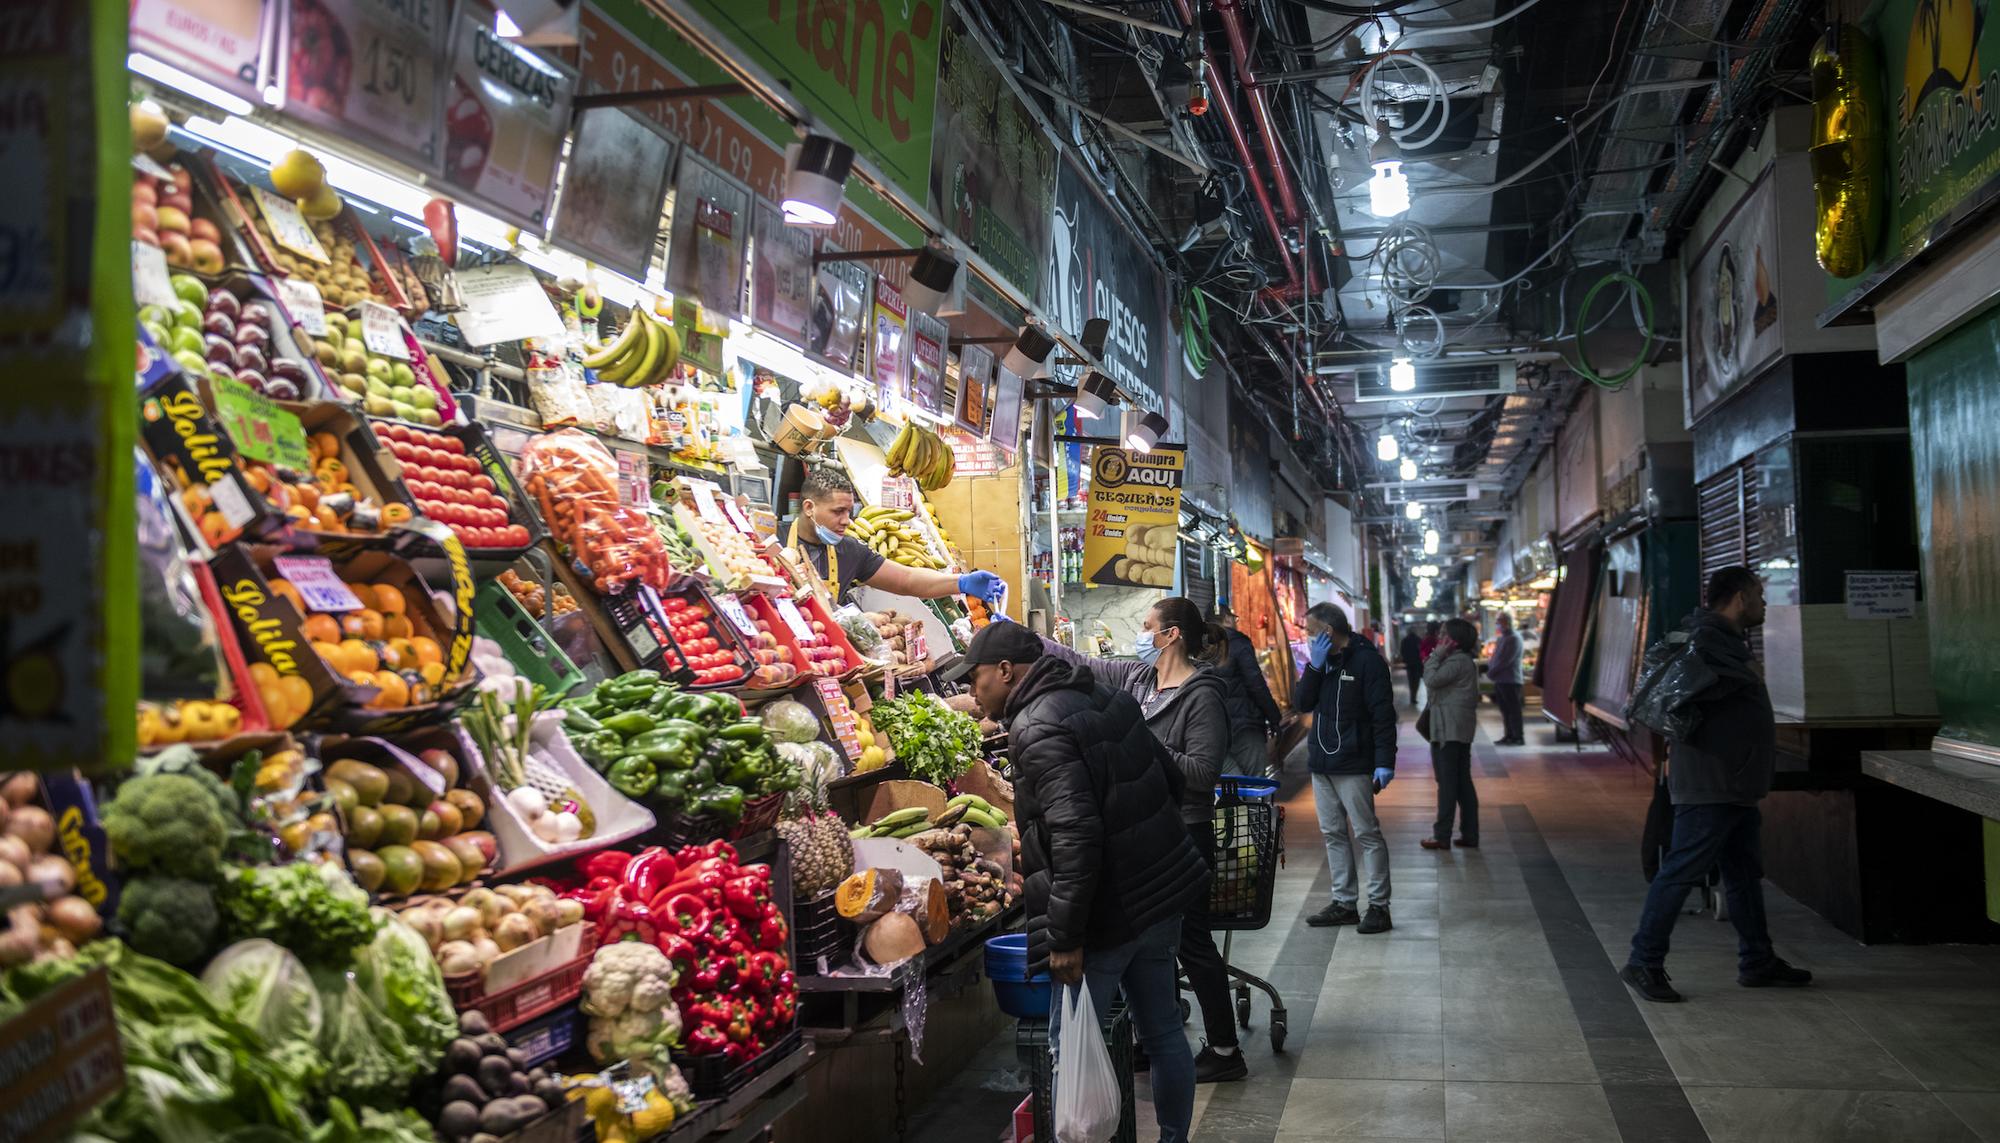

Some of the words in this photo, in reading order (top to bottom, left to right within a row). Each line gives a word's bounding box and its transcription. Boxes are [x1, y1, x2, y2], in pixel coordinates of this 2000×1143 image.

[473, 29, 560, 108] CEREZAS
[944, 24, 995, 115] SERVICIO
[878, 283, 906, 315] OFERTA
[1094, 278, 1148, 368] QUESOS
[1131, 450, 1176, 466] Compra
[1094, 490, 1175, 507] TEQUEÑOS
[1124, 505, 1174, 514] congelados
[1092, 508, 1107, 522] 24
[1092, 524, 1105, 537] 12
[220, 579, 301, 677] Lolita
